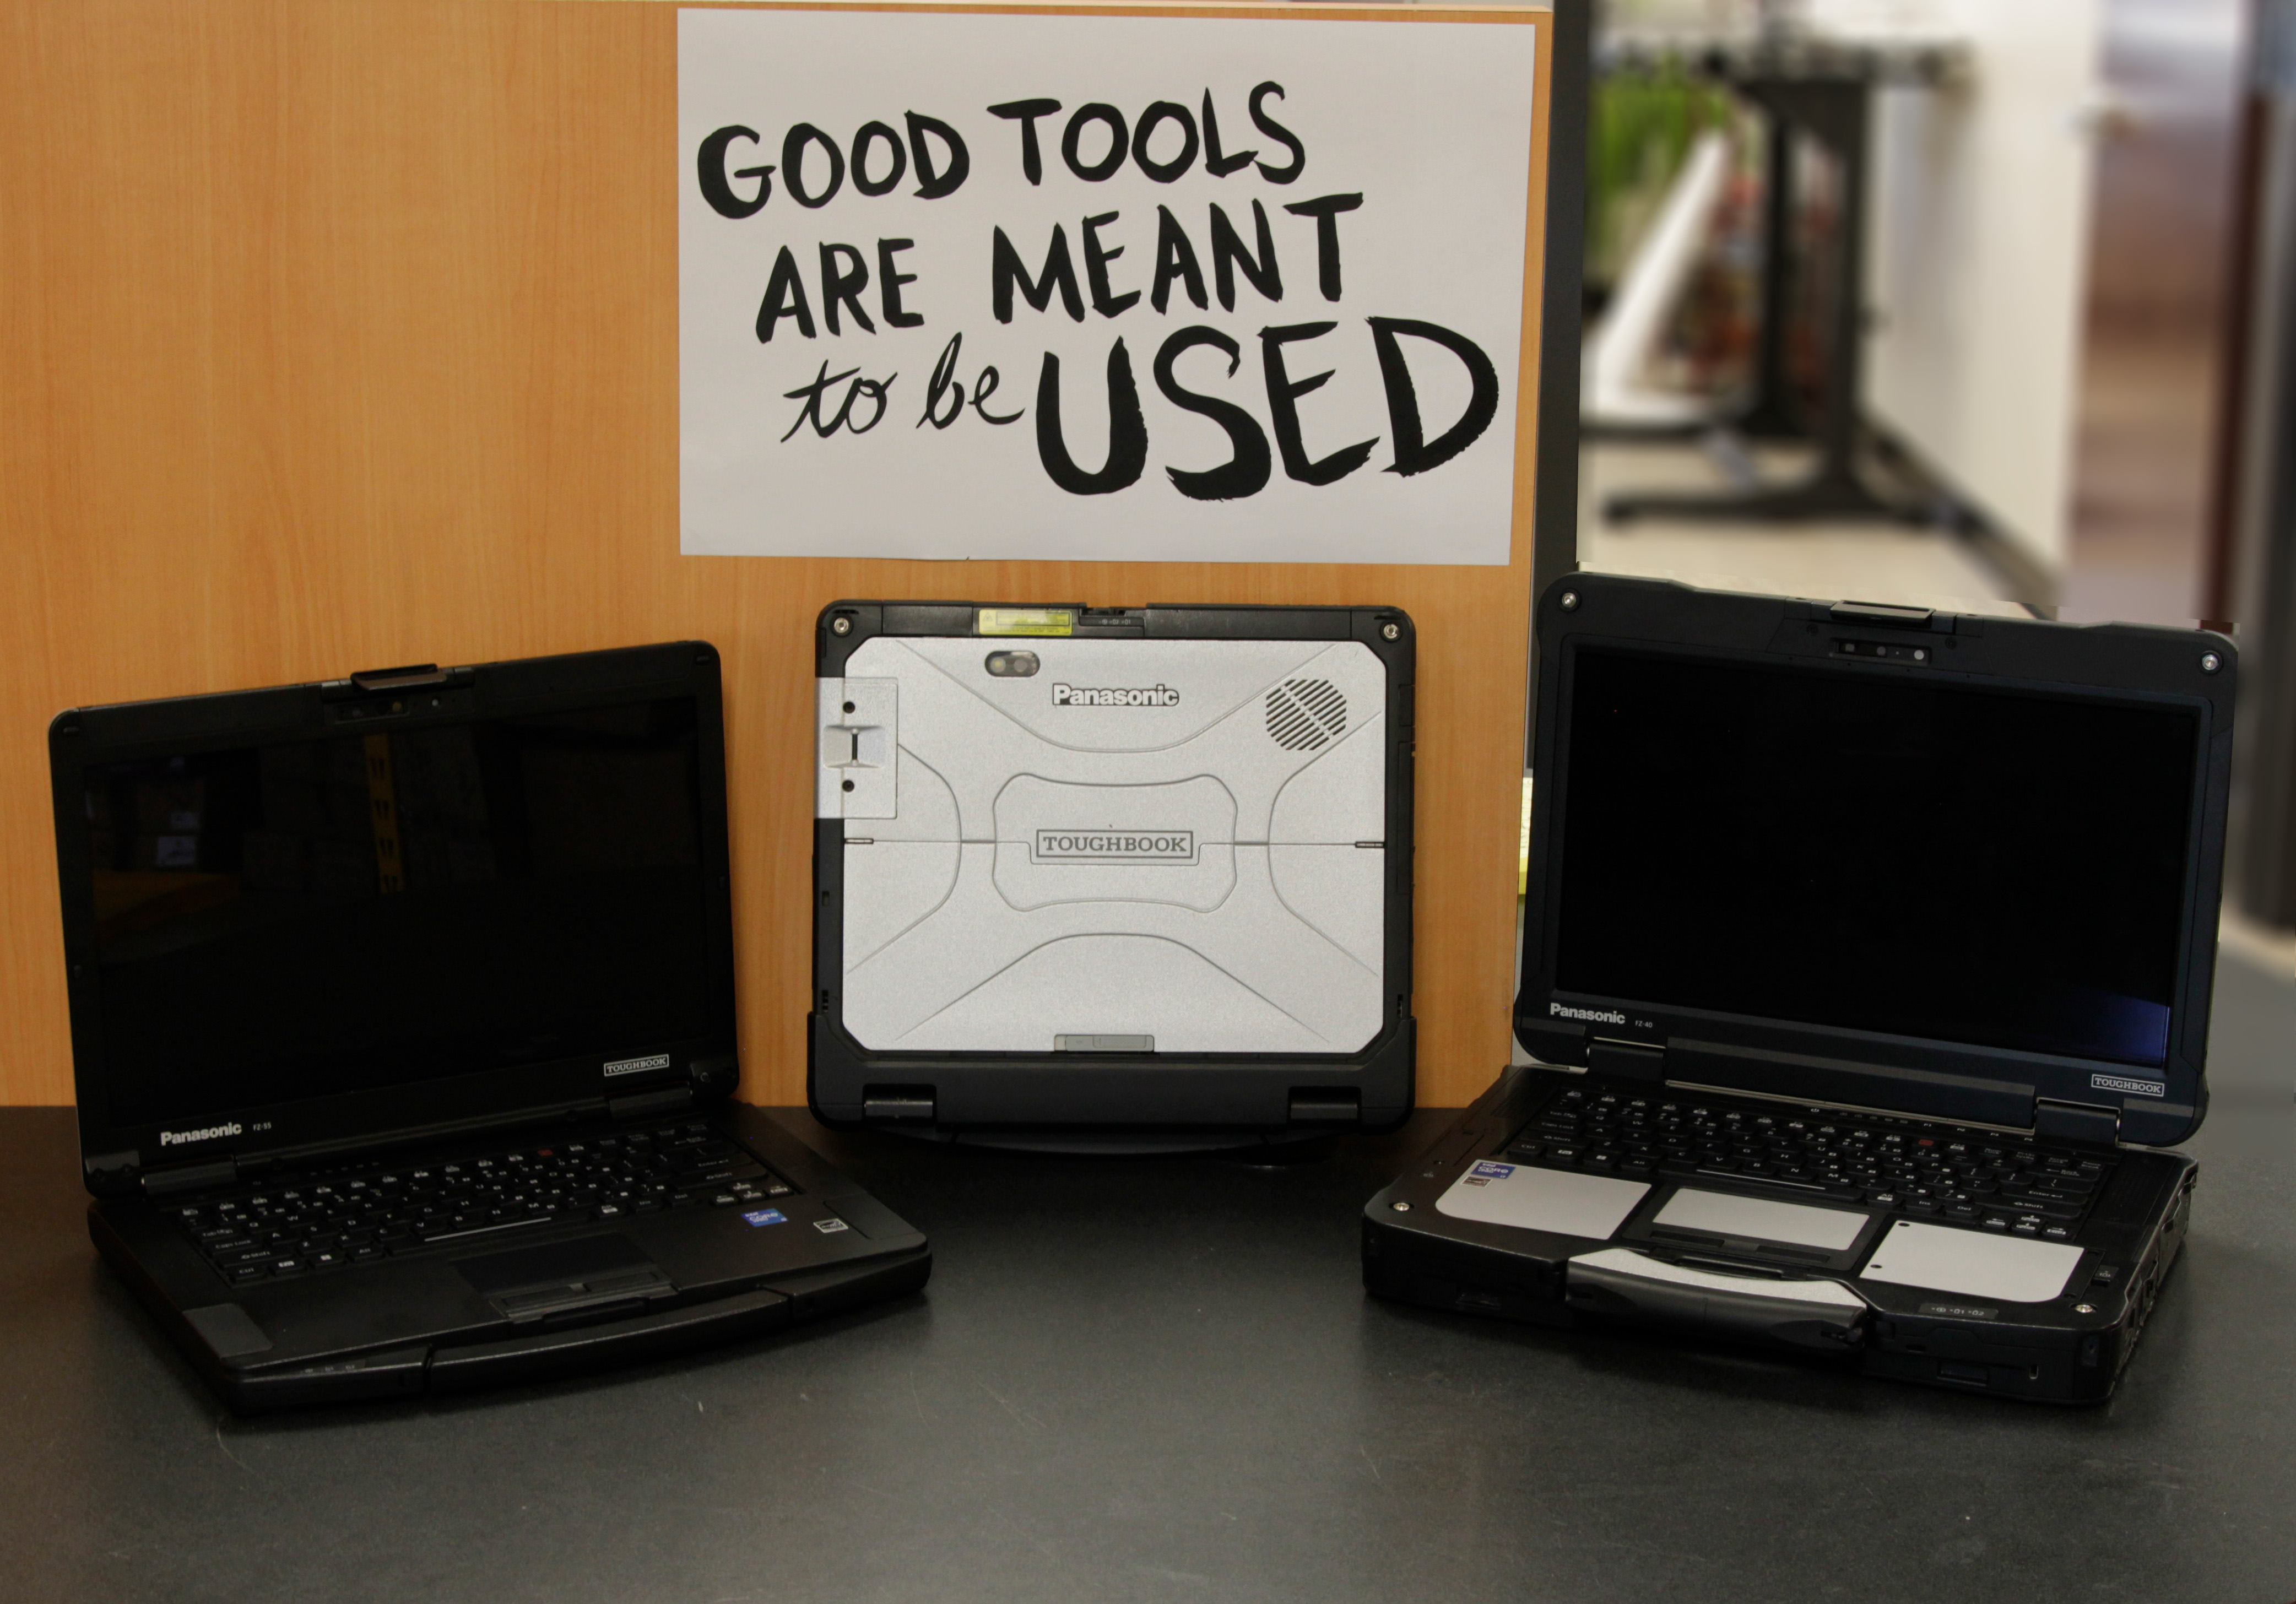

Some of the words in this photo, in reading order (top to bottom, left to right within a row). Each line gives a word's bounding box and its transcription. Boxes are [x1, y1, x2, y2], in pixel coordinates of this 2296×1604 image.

[696, 111, 971, 219] GOOD
[986, 81, 1305, 185] TOOLS
[756, 239, 924, 343] ARE
[993, 192, 1364, 323] MEANT
[781, 360, 897, 442] to
[917, 332, 1024, 429] be
[1036, 316, 1499, 502] USED
[1053, 683, 1179, 706] Panasonic
[1043, 836, 1187, 854] TOUGHBOOK
[1550, 1002, 1626, 1025] Panasonic
[607, 1056, 667, 1074] TOUGHBOOK
[2094, 1075, 2163, 1094] TOUGHBOOK
[160, 1122, 242, 1146] Panasonic
